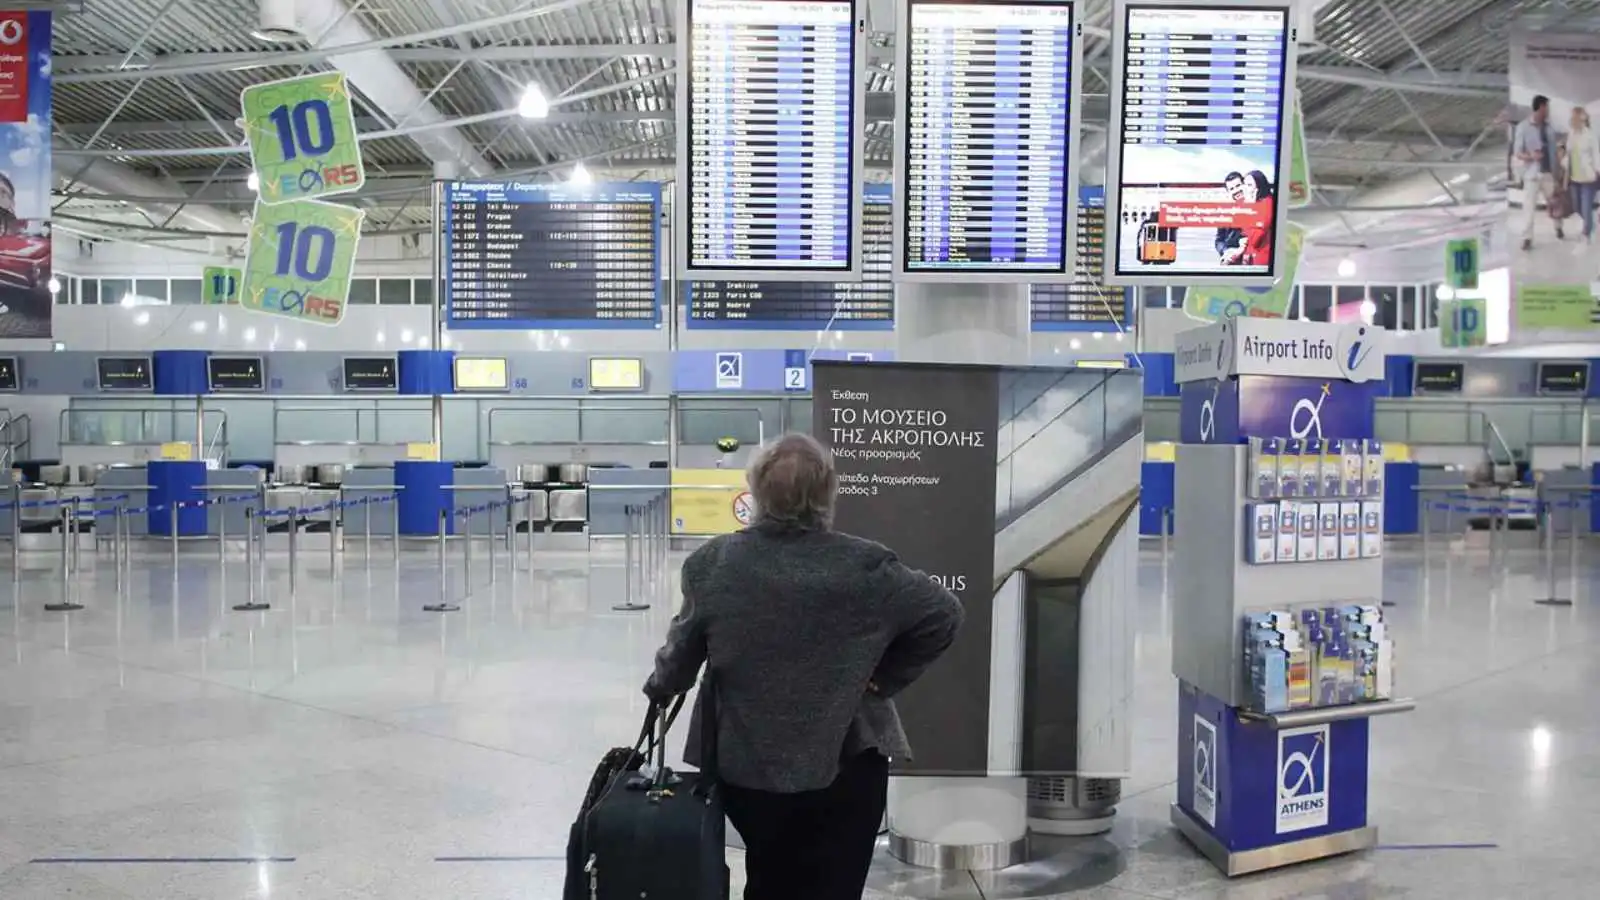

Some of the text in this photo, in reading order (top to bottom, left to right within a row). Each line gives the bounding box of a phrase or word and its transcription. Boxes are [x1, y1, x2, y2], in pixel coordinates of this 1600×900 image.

[268, 99, 335, 160] 10
[276, 222, 335, 281] 10
[1243, 335, 1298, 362] Airport
[1302, 339, 1333, 361] Info
[790, 369, 801, 386] 2
[831, 389, 870, 402] Έκθεση
[831, 408, 947, 426] ΤΟ ΜΟΥΣΕΙΟ
[830, 428, 985, 447] ΤΗΣ ΑΚΡΟΠΟΛΗΣ
[830, 448, 922, 461] Νέος προορισμός
[871, 473, 941, 486] Αναχωρήσεων
[871, 486, 878, 495] 3
[1280, 798, 1324, 816] ATHENS
